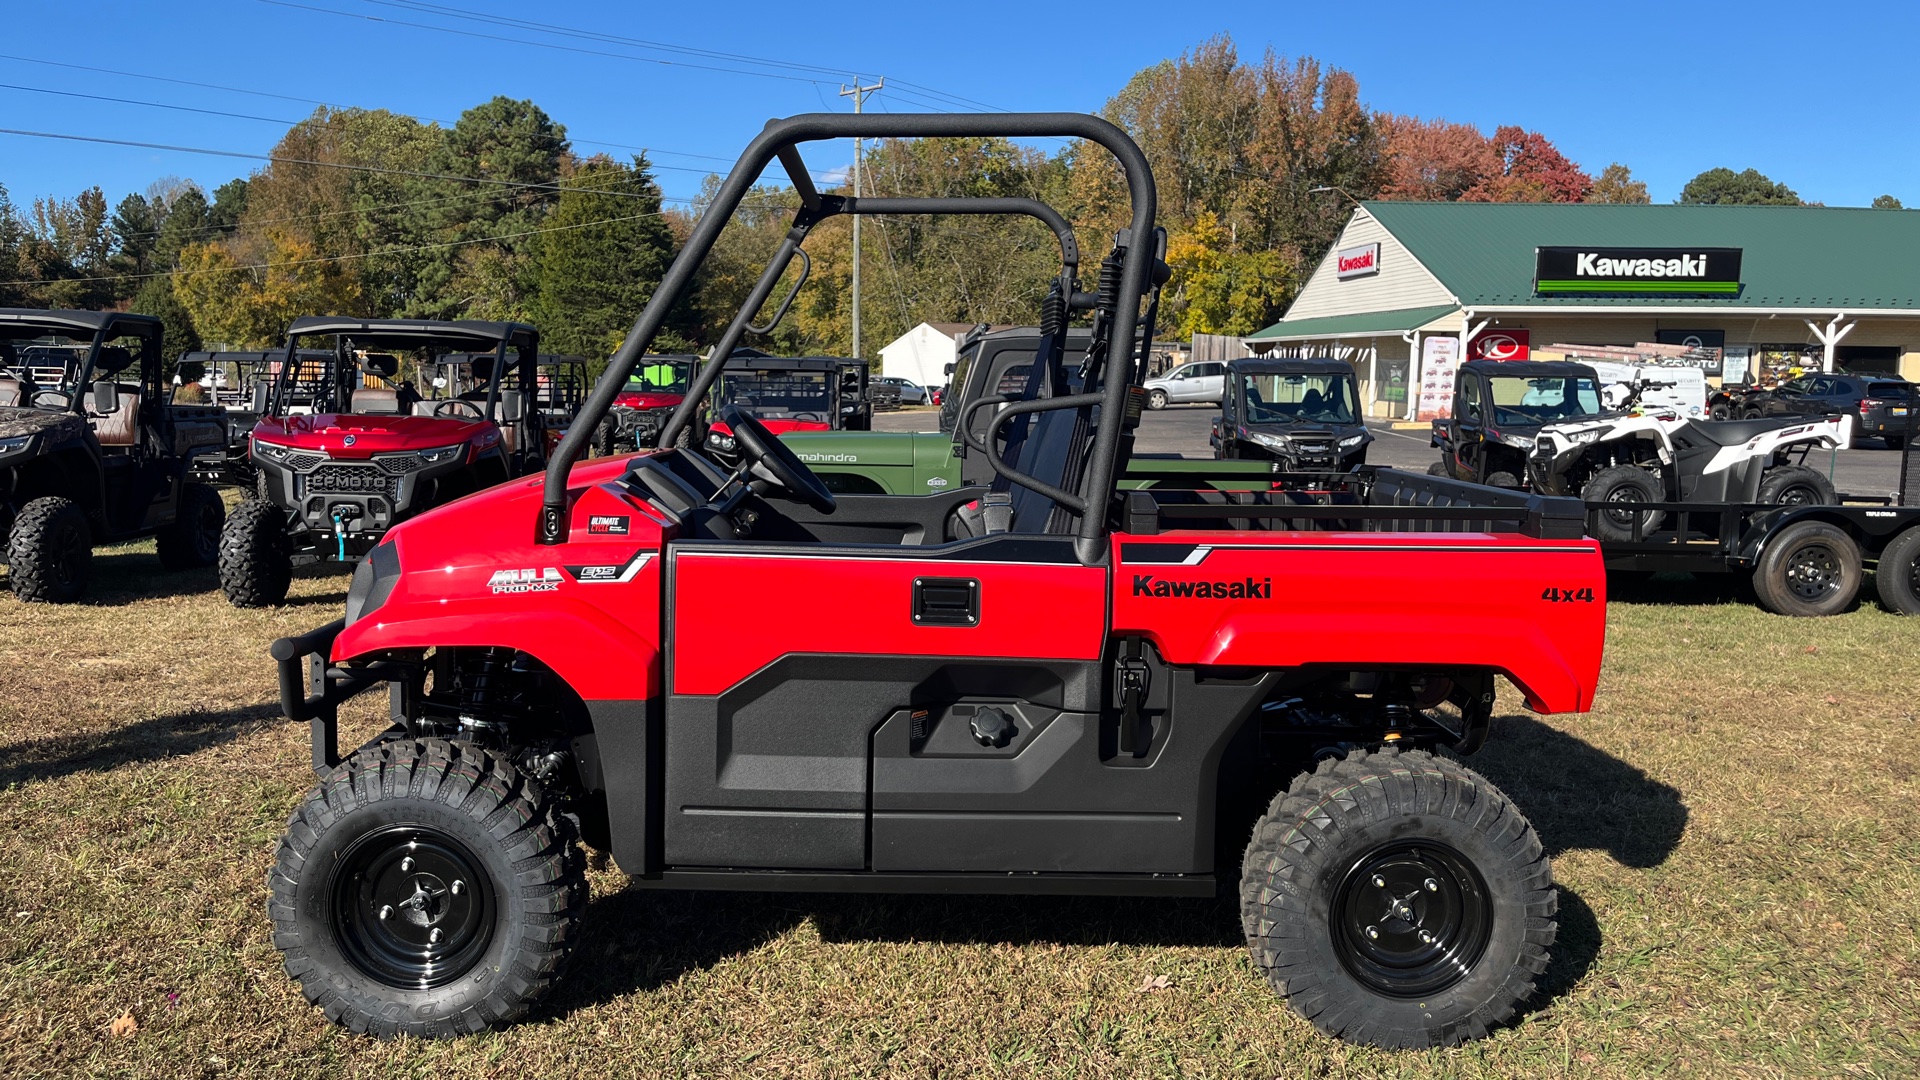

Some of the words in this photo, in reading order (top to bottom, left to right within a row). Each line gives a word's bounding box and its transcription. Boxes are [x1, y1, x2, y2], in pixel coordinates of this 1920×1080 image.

[1338, 250, 1374, 272] Kawasaki
[1576, 252, 1707, 277] Kawasaki
[797, 453, 857, 462] mahindra
[312, 475, 386, 488] CFMOTO
[591, 517, 619, 525] ULTIMATE
[487, 567, 565, 586] MULE
[1133, 575, 1271, 599] Kawasaki
[1541, 587, 1595, 603] 4x4
